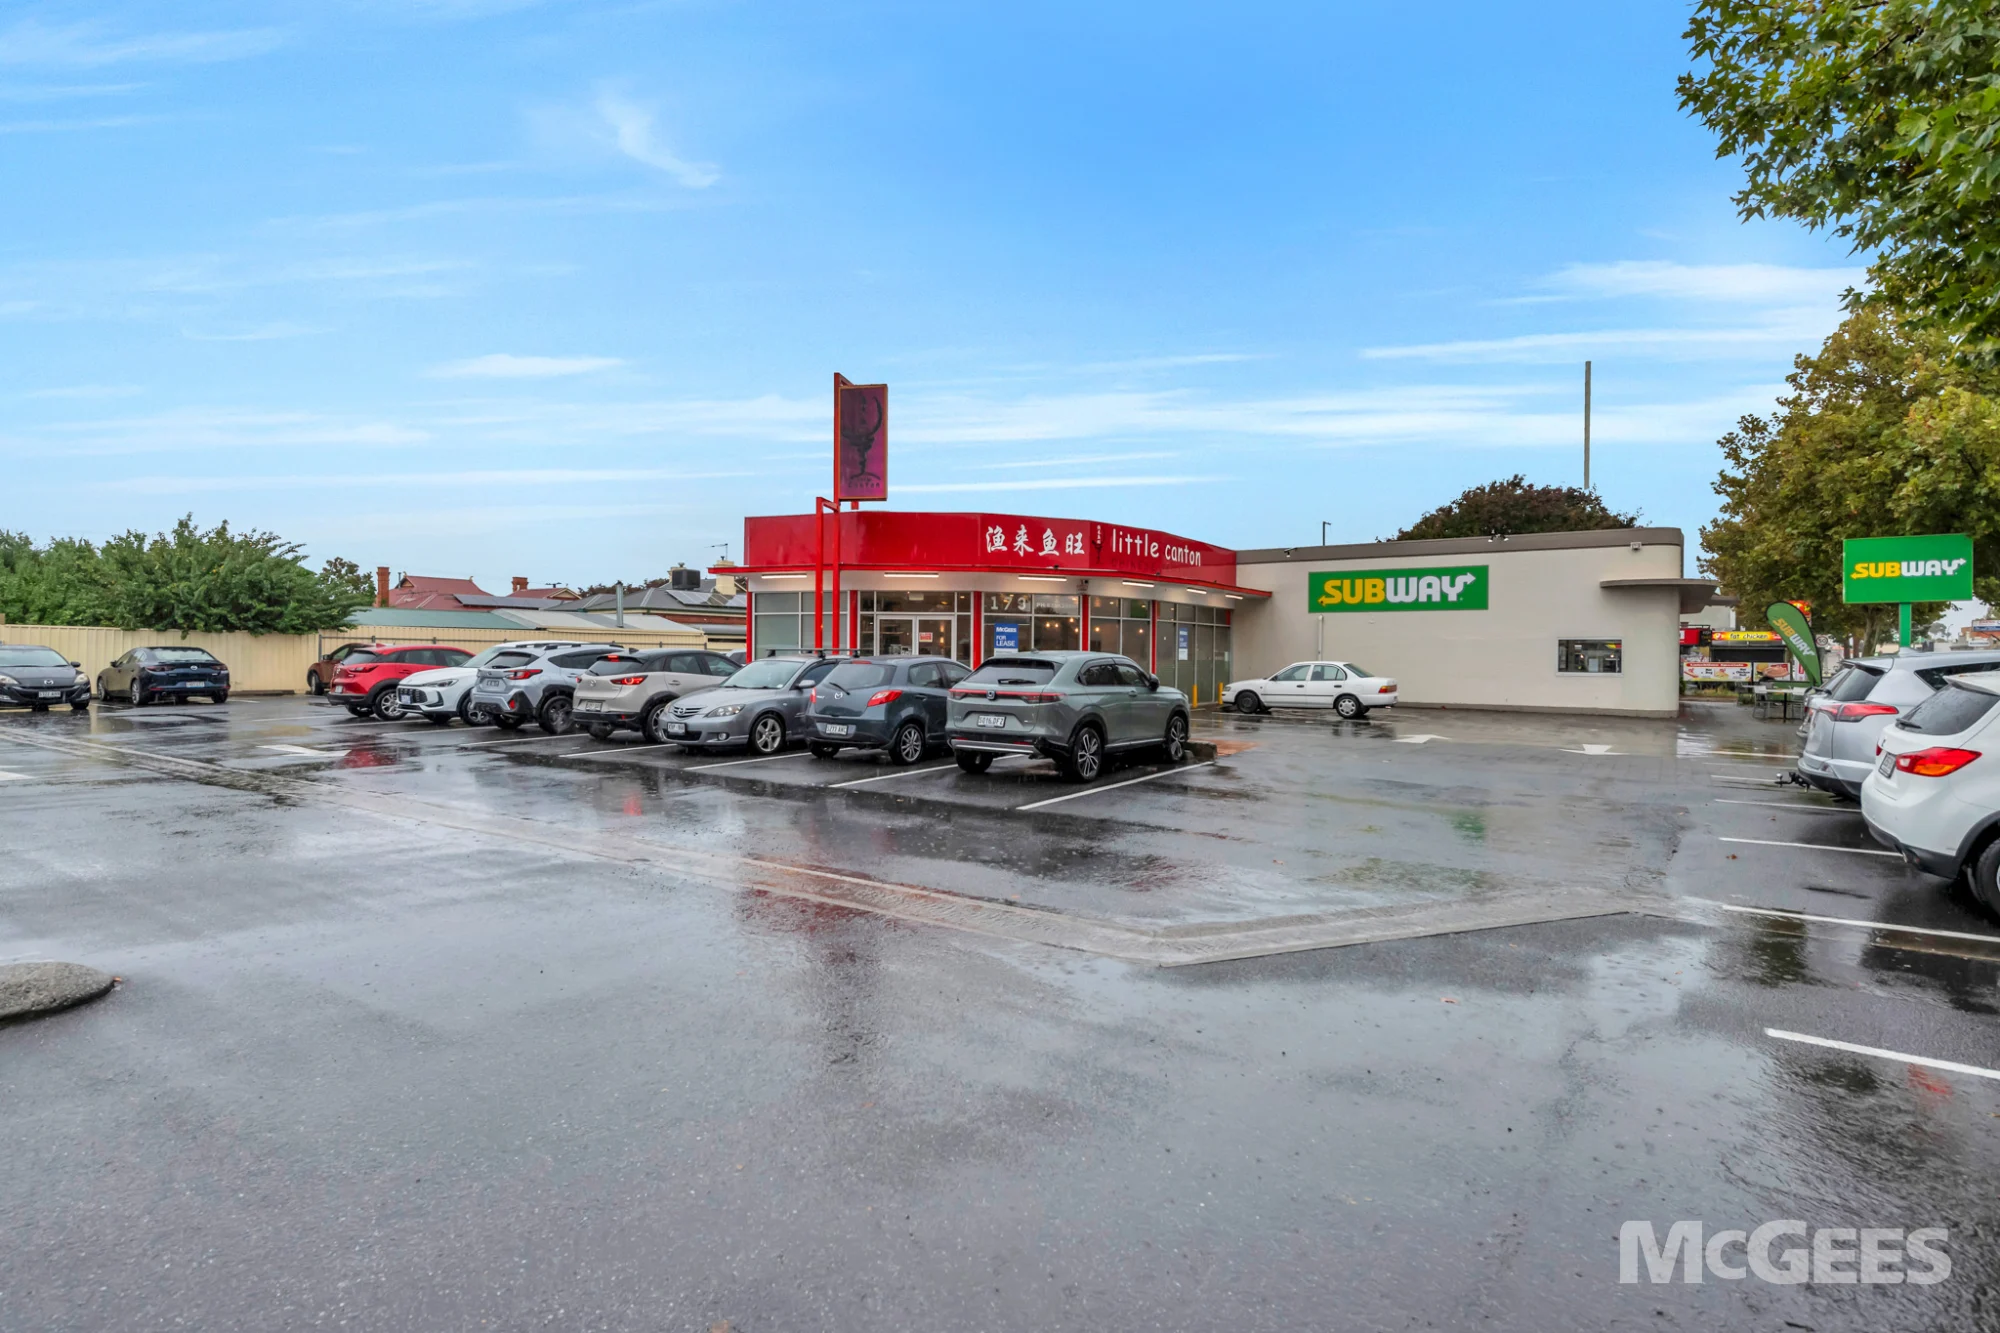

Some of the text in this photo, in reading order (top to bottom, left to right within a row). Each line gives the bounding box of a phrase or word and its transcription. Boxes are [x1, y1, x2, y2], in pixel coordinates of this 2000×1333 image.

[985, 523, 1085, 557] 渔来鱼旺
[1111, 528, 1160, 558] little
[1164, 544, 1201, 567] canton
[1850, 558, 1967, 580] SUBWAY
[991, 596, 1026, 610] 173
[1318, 572, 1476, 606] SUBWAY
[1730, 632, 1740, 640] fat
[1743, 631, 1769, 640] chicken
[1773, 618, 1816, 656] SUBWAY
